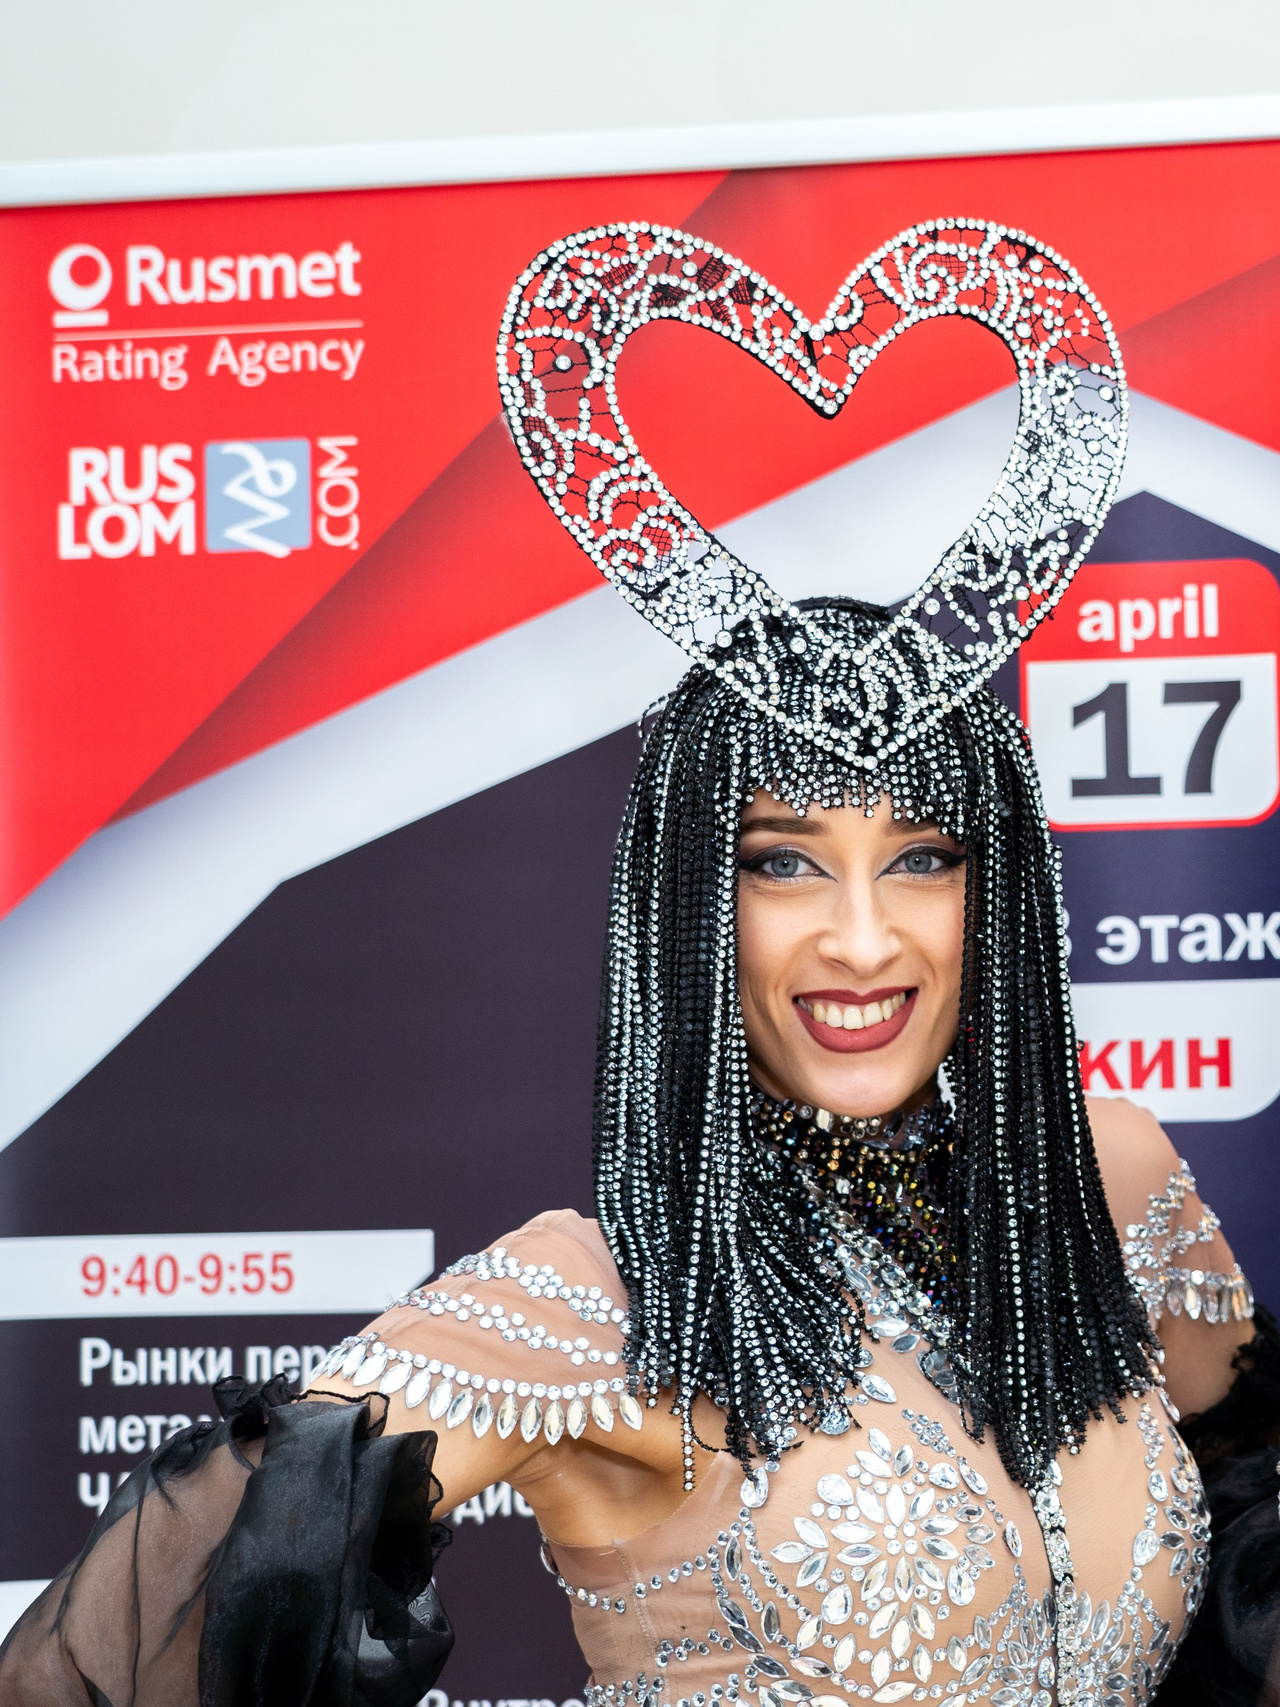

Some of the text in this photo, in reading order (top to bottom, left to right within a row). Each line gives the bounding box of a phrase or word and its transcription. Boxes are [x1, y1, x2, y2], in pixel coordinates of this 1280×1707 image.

[126, 241, 362, 306] Rusmet
[52, 336, 365, 391] Rating Agency
[68, 443, 196, 506] RUS
[58, 499, 196, 560] LOM
[1077, 583, 1219, 652] april
[1070, 680, 1242, 799] 17
[1078, 1037, 1232, 1091] кин
[81, 1252, 295, 1297] 9:40-9:55
[79, 1337, 337, 1390] Рынки пер
